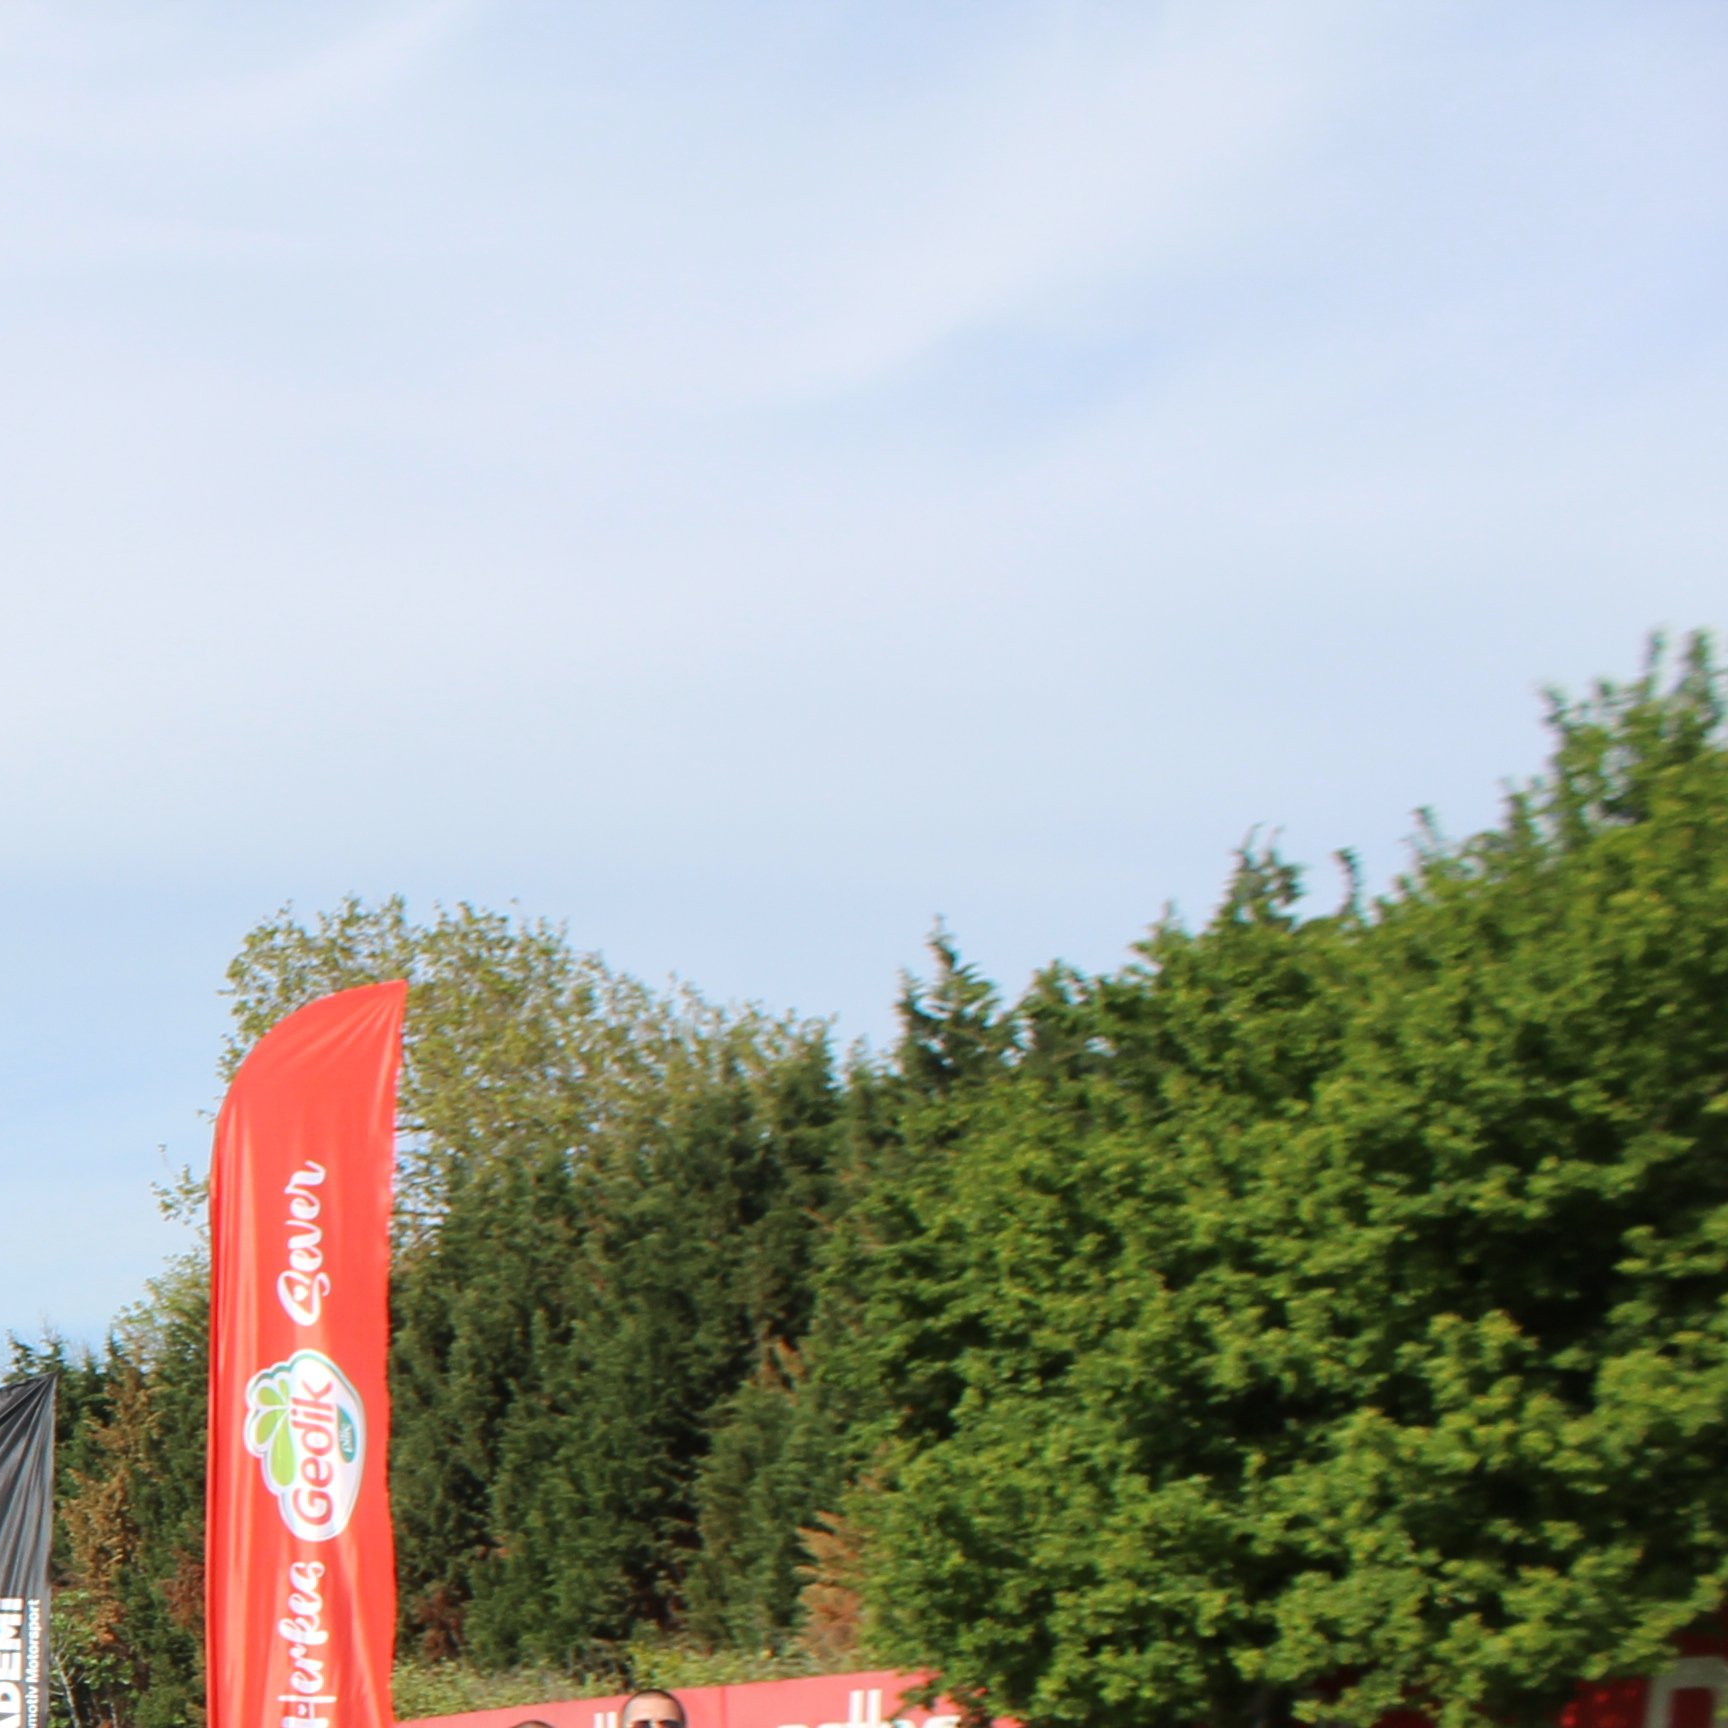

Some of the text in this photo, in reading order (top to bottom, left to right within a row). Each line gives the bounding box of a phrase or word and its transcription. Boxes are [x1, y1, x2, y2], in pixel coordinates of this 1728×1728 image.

[276, 1159, 331, 1327] Sever
[292, 1379, 334, 1526] Gedik
[25, 1599, 41, 1683] Motorsport
